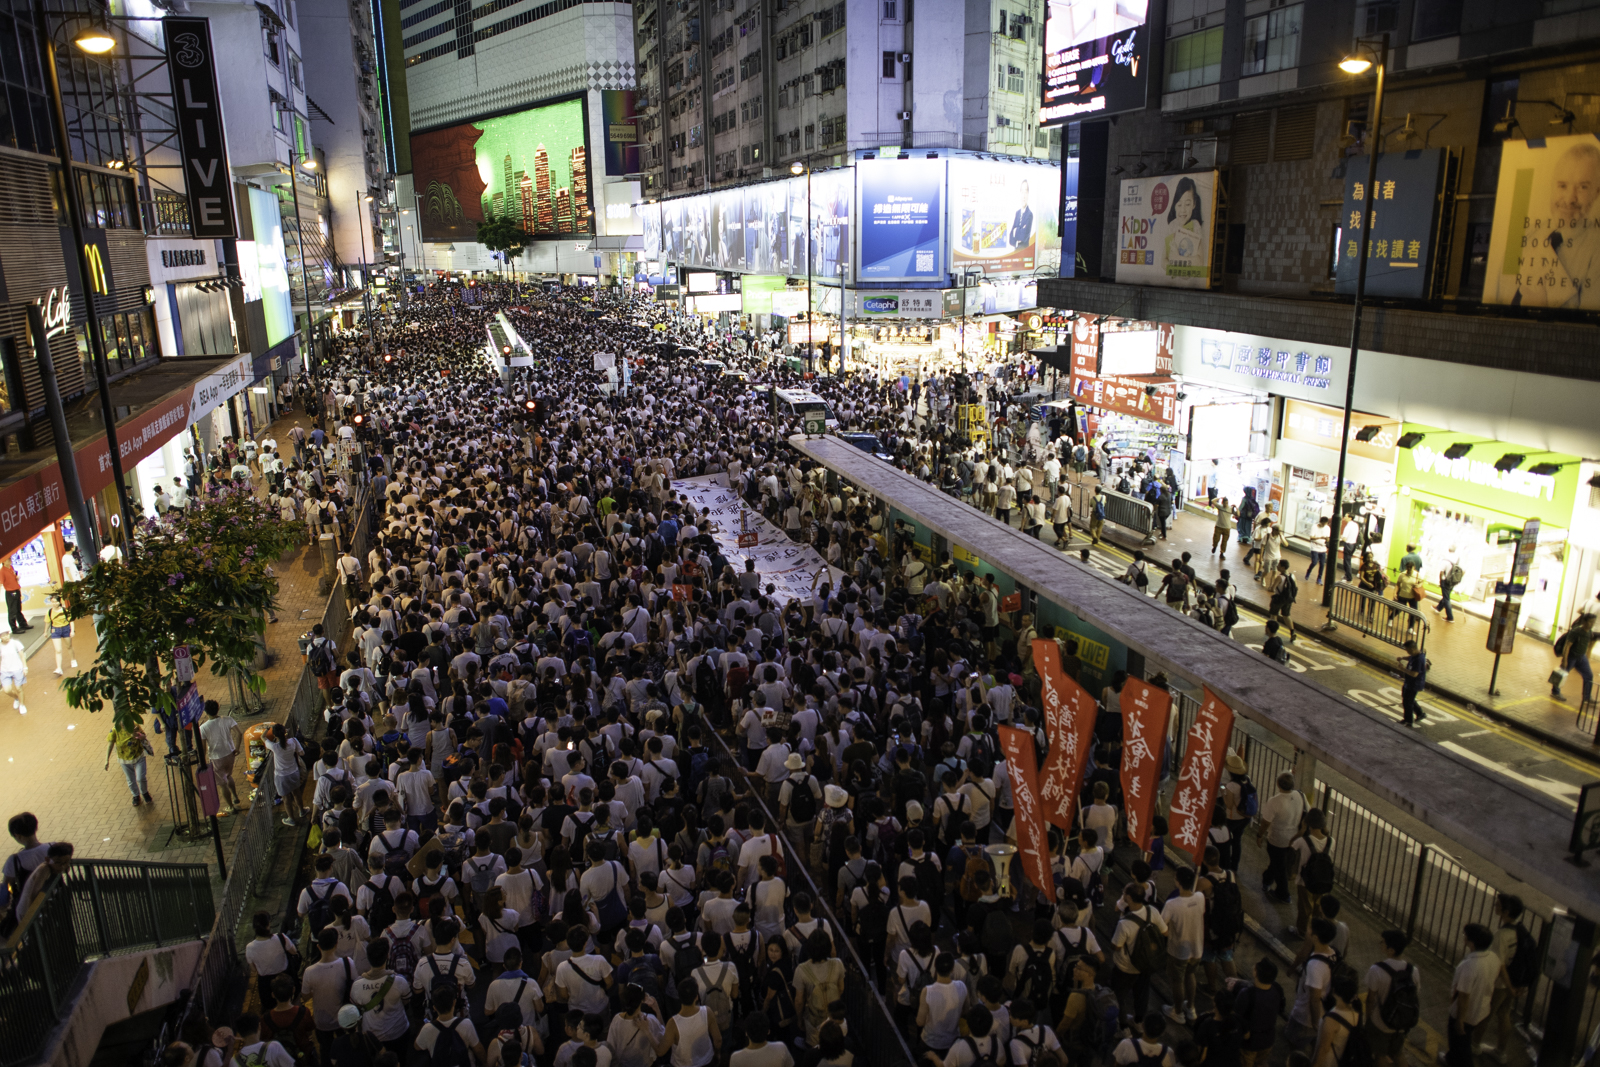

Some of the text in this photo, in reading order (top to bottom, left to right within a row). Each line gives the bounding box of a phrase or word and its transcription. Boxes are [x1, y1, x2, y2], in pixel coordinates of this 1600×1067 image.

[1111, 30, 1137, 57] Castle
[182, 78, 225, 227] LIVE
[1121, 234, 1148, 250] LAND
[1521, 236, 1574, 248] BOOS
[1518, 257, 1560, 268] WITH
[1515, 273, 1592, 288] READERS
[866, 300, 896, 310] Cetaphil
[1156, 356, 1173, 371] ENTR
[1237, 345, 1332, 375] 商務印書館
[1234, 364, 1331, 390] THE COMMERCIAL PRESS
[199, 386, 219, 406] BEA App
[120, 440, 133, 458] BEA
[132, 436, 143, 451] App
[1, 482, 60, 533] BEA 東亞銀行
[1081, 638, 1107, 666] LIVE!
